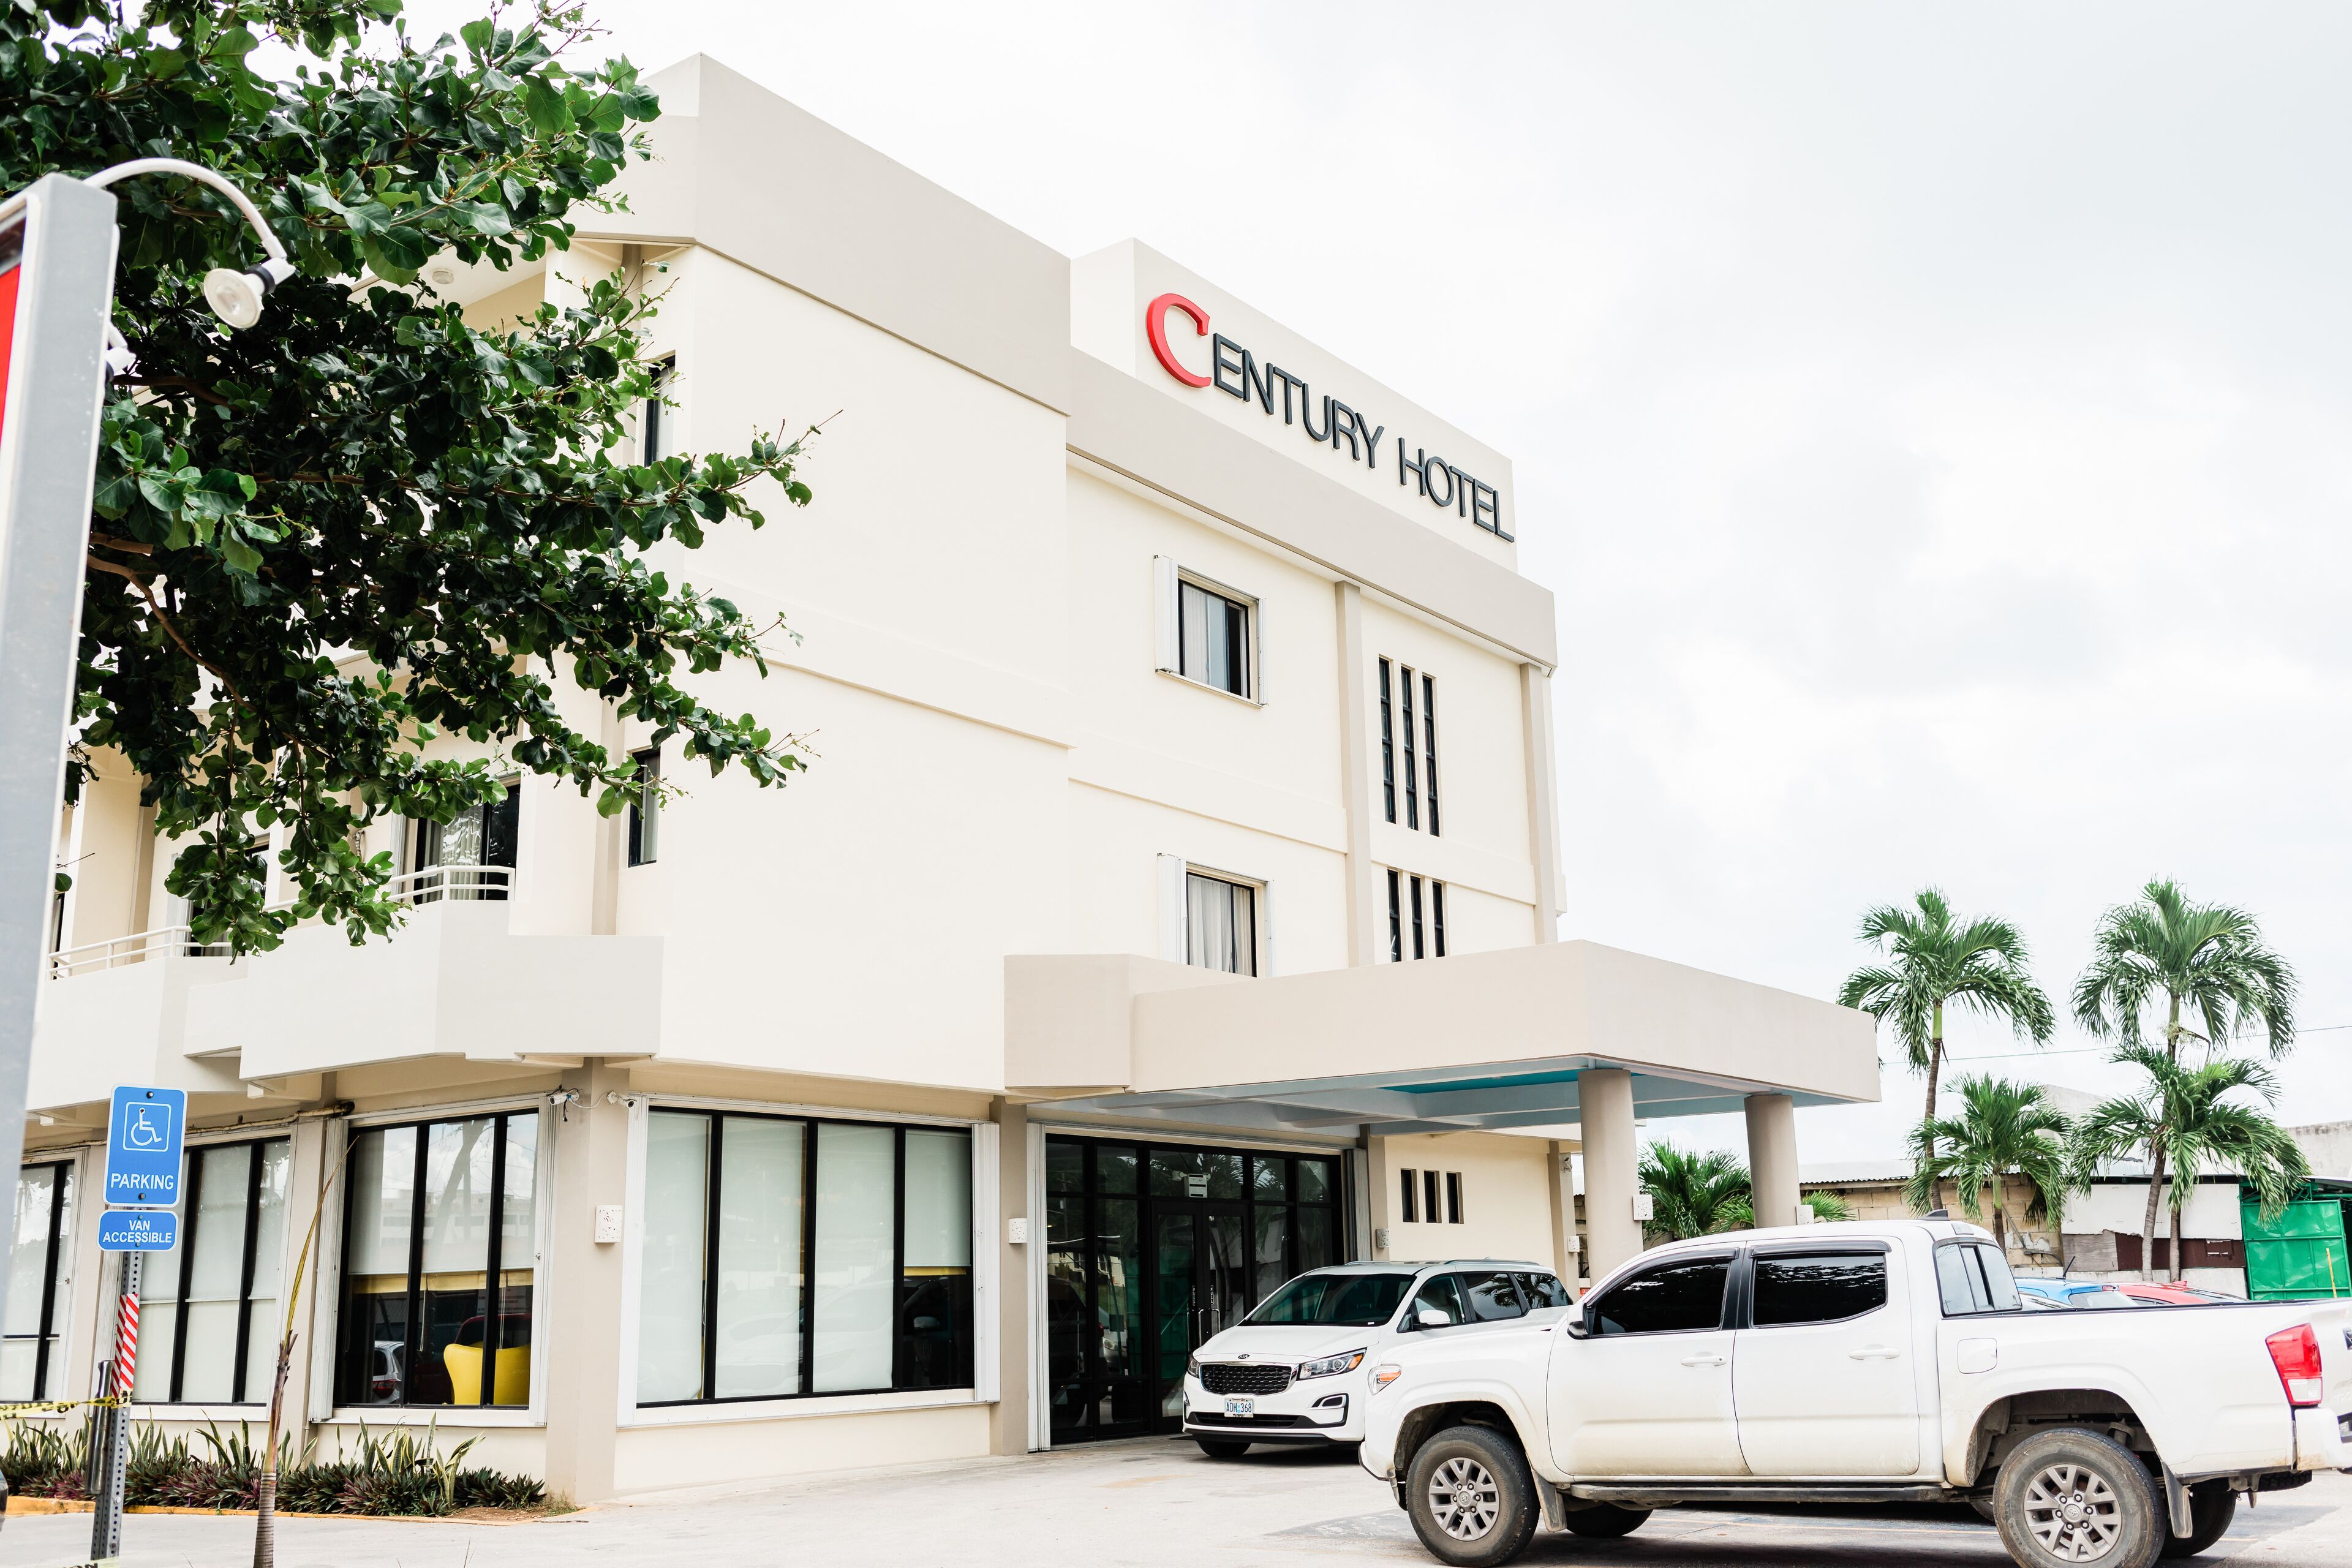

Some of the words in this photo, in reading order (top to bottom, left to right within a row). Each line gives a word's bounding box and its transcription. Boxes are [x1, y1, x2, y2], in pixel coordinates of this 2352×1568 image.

[1146, 293, 1385, 469] CENTURY
[1398, 437, 1515, 543] HOTEL
[110, 1173, 175, 1190] PARKING
[129, 1219, 151, 1231] VAN
[102, 1232, 172, 1243] ACCESSIBLE
[1226, 1403, 1237, 1412] ADH
[1241, 1403, 1252, 1413] 368
